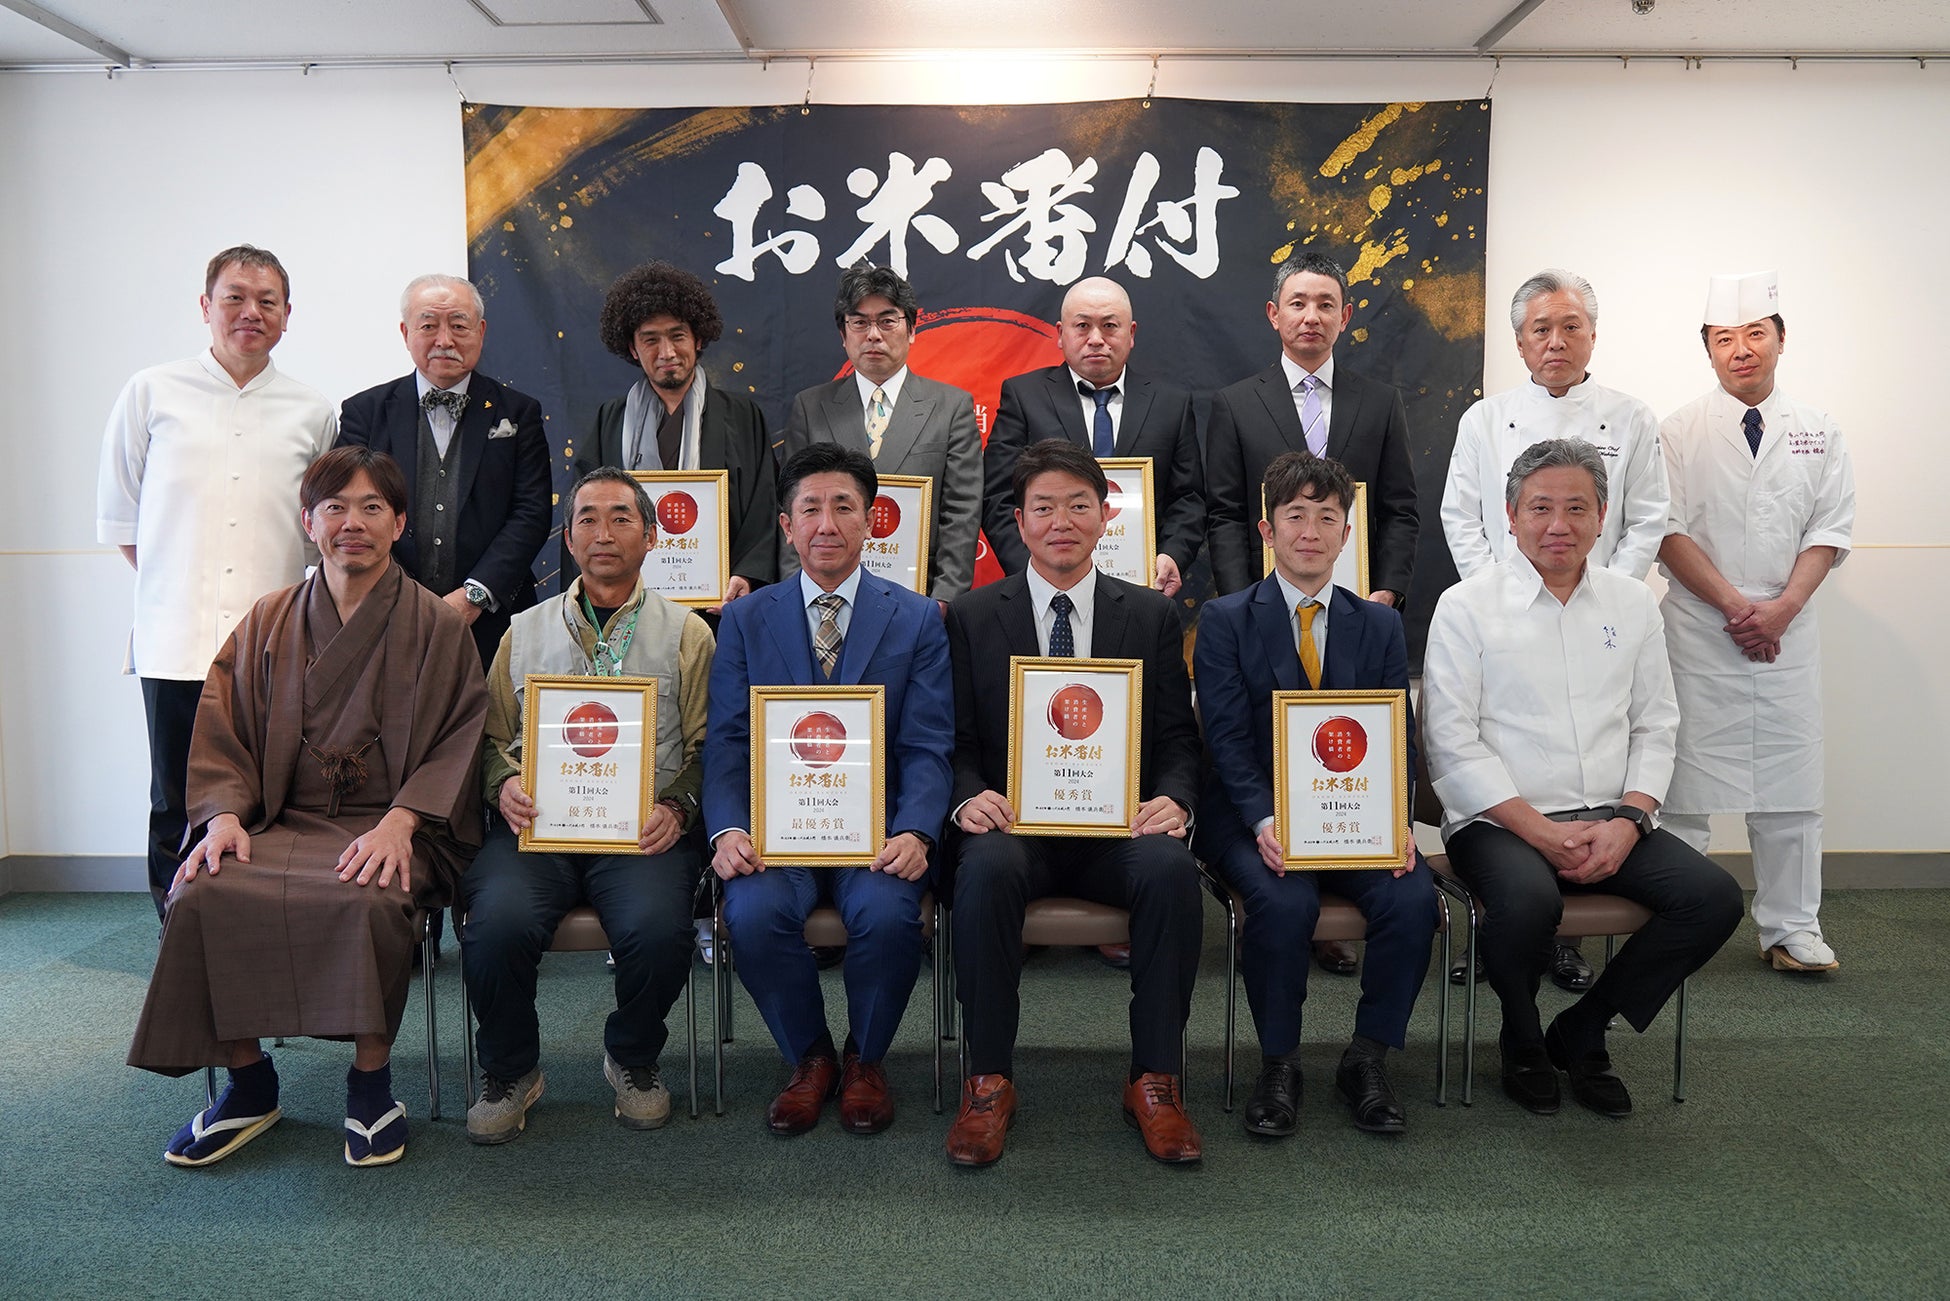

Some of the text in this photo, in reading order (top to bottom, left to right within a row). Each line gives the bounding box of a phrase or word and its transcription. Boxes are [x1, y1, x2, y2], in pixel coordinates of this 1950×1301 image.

[713, 146, 1240, 286] お米番付
[668, 572, 687, 582] 入賞
[1046, 744, 1104, 760] お米番付
[560, 762, 619, 778] お米番付
[1054, 768, 1094, 778] 第11回大会
[789, 773, 848, 788] お米番付
[1312, 777, 1369, 792] お米番付
[568, 785, 609, 795] 第11回大会
[1054, 788, 1093, 801] 優秀賞
[798, 797, 839, 807] 第11回大会
[1321, 801, 1361, 810] 第11回大会
[568, 806, 608, 818] 優秀賞
[791, 818, 845, 830] 最優秀賞
[1322, 821, 1360, 834] 優秀賞
